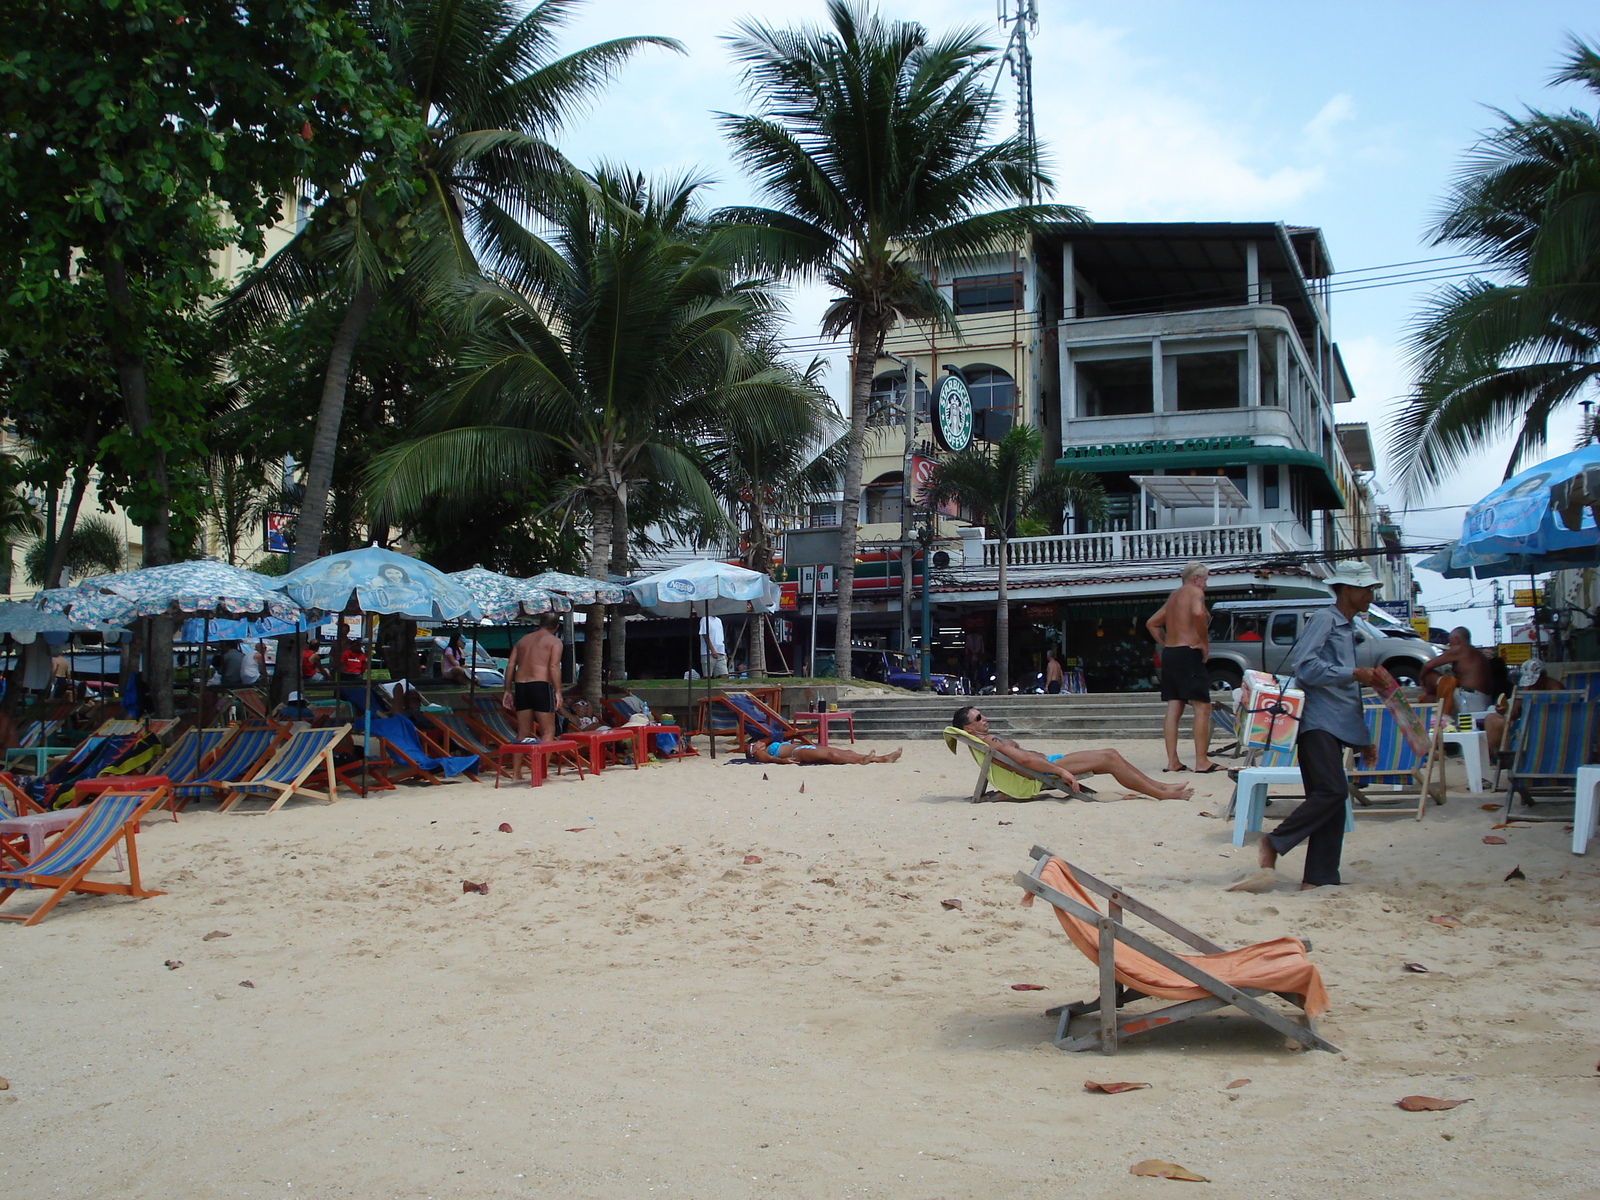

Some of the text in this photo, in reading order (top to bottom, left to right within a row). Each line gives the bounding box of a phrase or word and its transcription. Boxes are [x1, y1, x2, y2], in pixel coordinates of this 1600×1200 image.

[940, 377, 970, 415] STARBUCKS
[943, 425, 968, 448] COFFEE
[1066, 436, 1255, 458] STARBUCKS COFFEE
